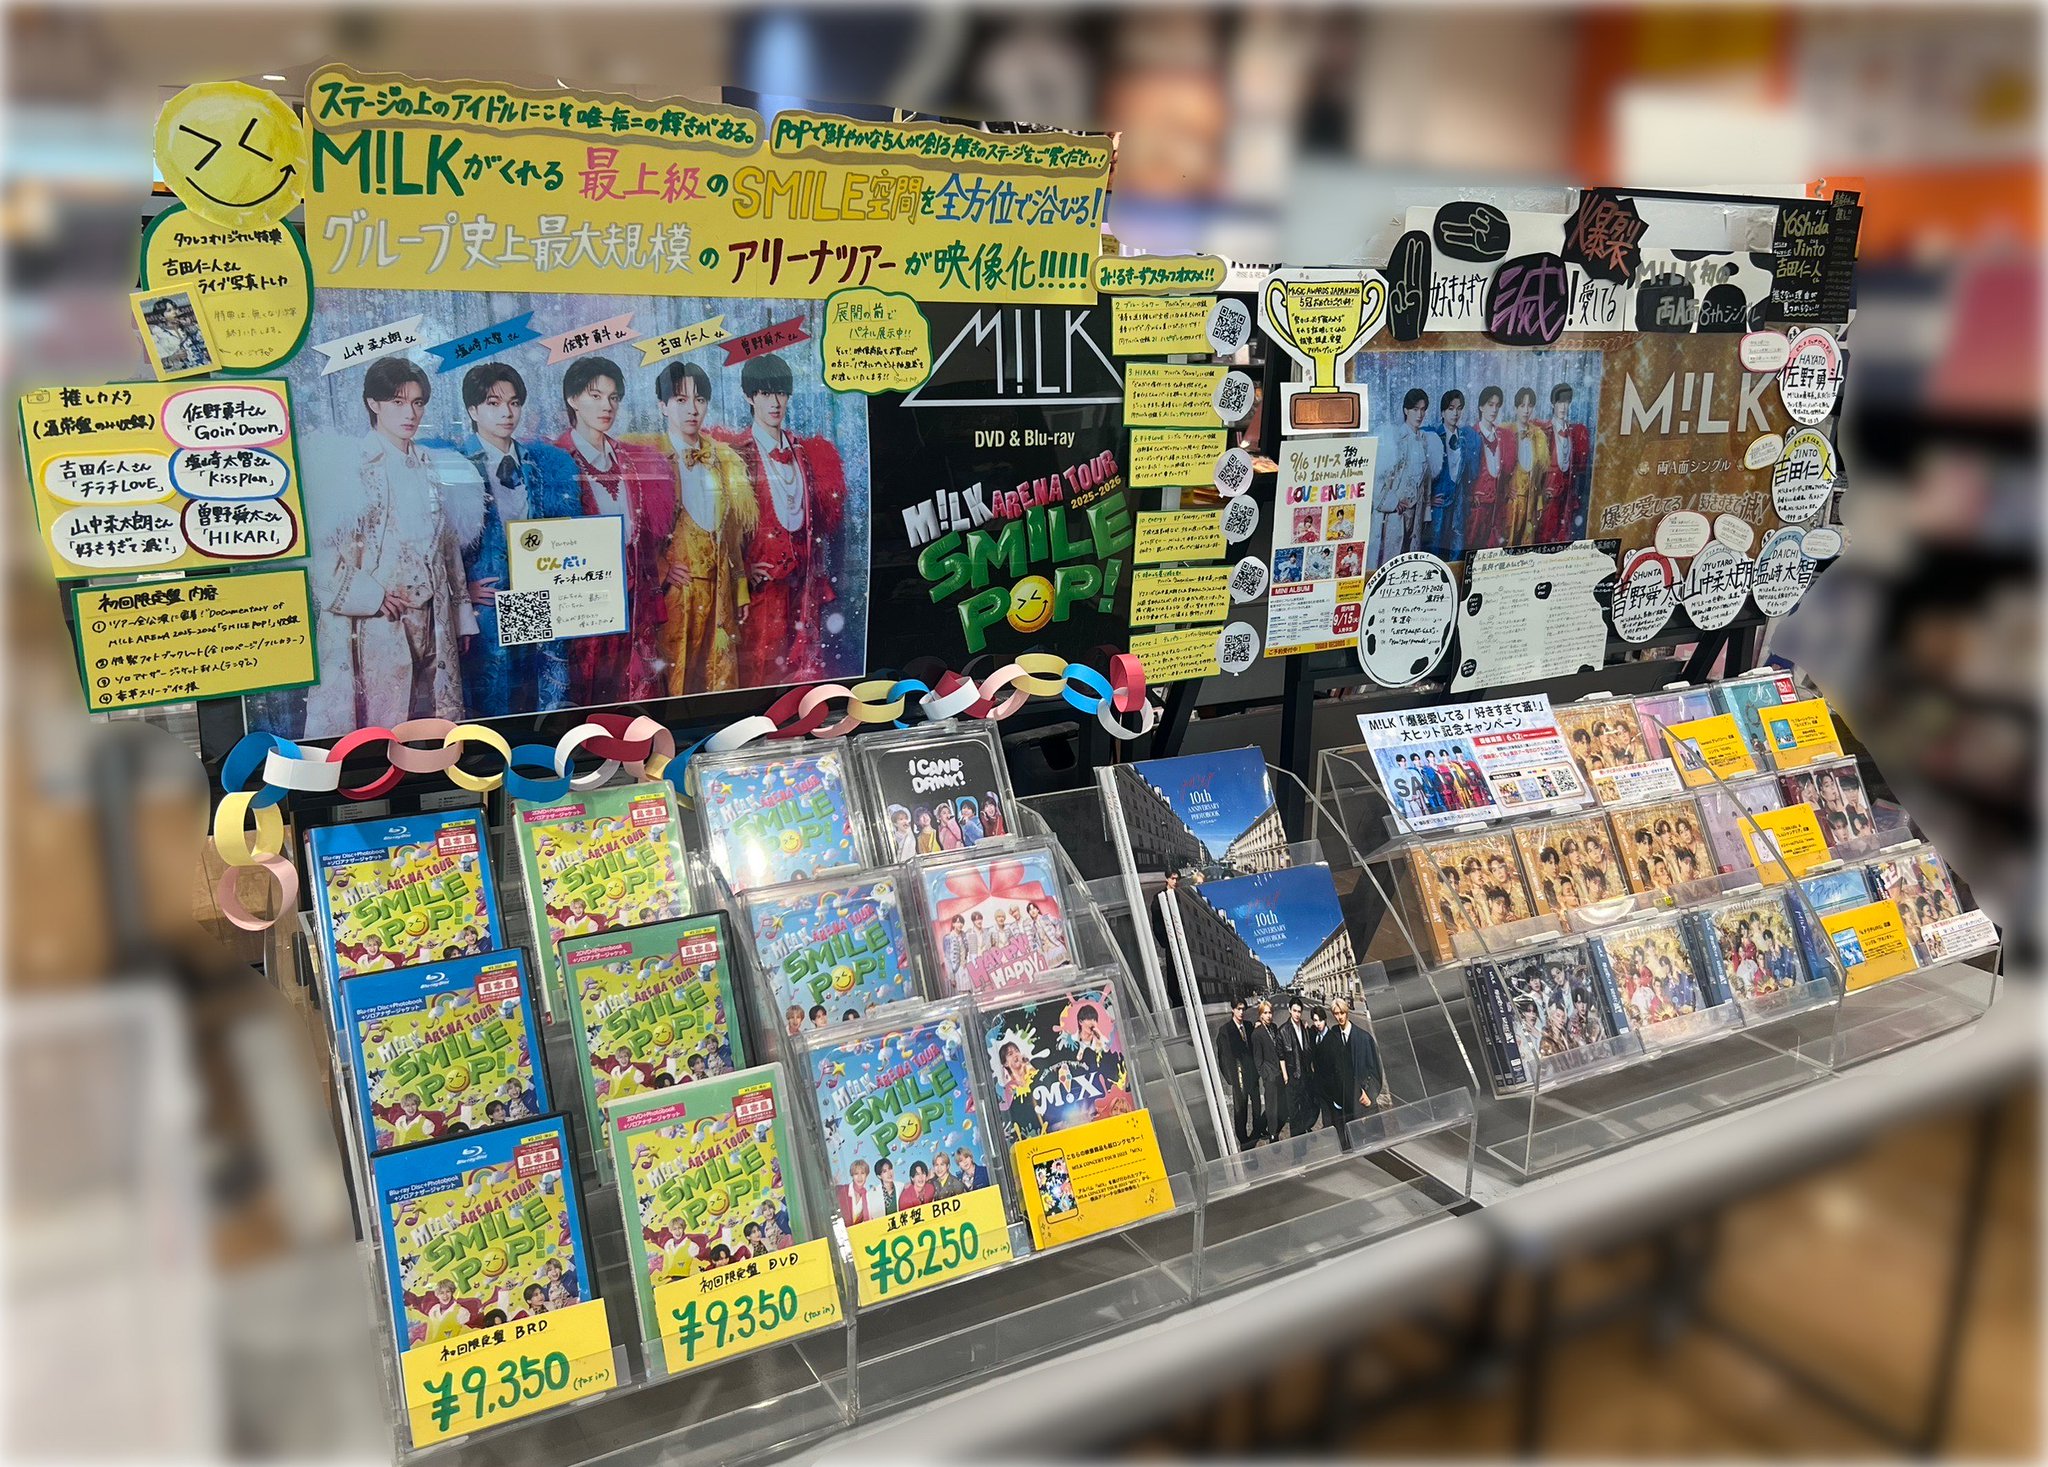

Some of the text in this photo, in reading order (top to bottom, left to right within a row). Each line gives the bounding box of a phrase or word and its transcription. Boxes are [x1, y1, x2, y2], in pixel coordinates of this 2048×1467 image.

[163, 258, 241, 276] 吉田仁人さん
[1799, 354, 1826, 366] HAYATO
[1620, 371, 1776, 436] M!LK
[975, 429, 1075, 448] DVD & Blu-ray
[1794, 448, 1819, 460] JINTO
[1657, 459, 1732, 476] 両A面シングル
[902, 482, 994, 548] M!LK
[991, 473, 1064, 519] ARENA
[1063, 449, 1118, 494] TOUR
[1070, 475, 1122, 509] 2025-2026
[1286, 482, 1365, 506] LOVE ENGINE
[917, 492, 1134, 604] SMILE
[1772, 548, 1799, 560] DAICHI
[536, 556, 587, 571] じんだい
[1632, 569, 1662, 582] SHUNTA
[1702, 559, 1733, 572] JYUTARO
[1369, 718, 1396, 731] M!LK
[1401, 717, 1522, 742] 大ヒット記念キャンペーン
[1187, 803, 1220, 814] ANNIVERSARY
[1189, 788, 1213, 804] 10th
[1191, 811, 1220, 821] PHOTOBOOK
[587, 829, 646, 860] ARENA TOUR
[387, 856, 455, 891] ARENA TOUR
[560, 844, 660, 893] SMILE
[353, 873, 470, 929] SMILE
[810, 903, 875, 943] ARENA TOUR
[1253, 925, 1287, 937] ANNIVERSARY
[1255, 910, 1279, 927] 10th
[1256, 934, 1287, 945] PHOTOBOOK
[782, 922, 891, 984] SMILE
[633, 967, 696, 1002] ARENA TOUR
[424, 1003, 496, 1044] ARENA TOUR
[604, 982, 709, 1041] SMILE
[389, 1020, 512, 1086] SMILE
[874, 1059, 913, 1088] ARENA
[911, 1043, 941, 1068] TOUR
[845, 1062, 959, 1137] SMILE
[687, 1127, 751, 1169] ARENA TOUR
[657, 1143, 766, 1211] SMILE
[460, 1201, 502, 1226] ARENA
[502, 1178, 536, 1204] TOUR
[931, 1198, 962, 1219] BRD
[423, 1195, 553, 1272] SMILE
[769, 1252, 799, 1271] DVD
[515, 1319, 549, 1340] BRD
